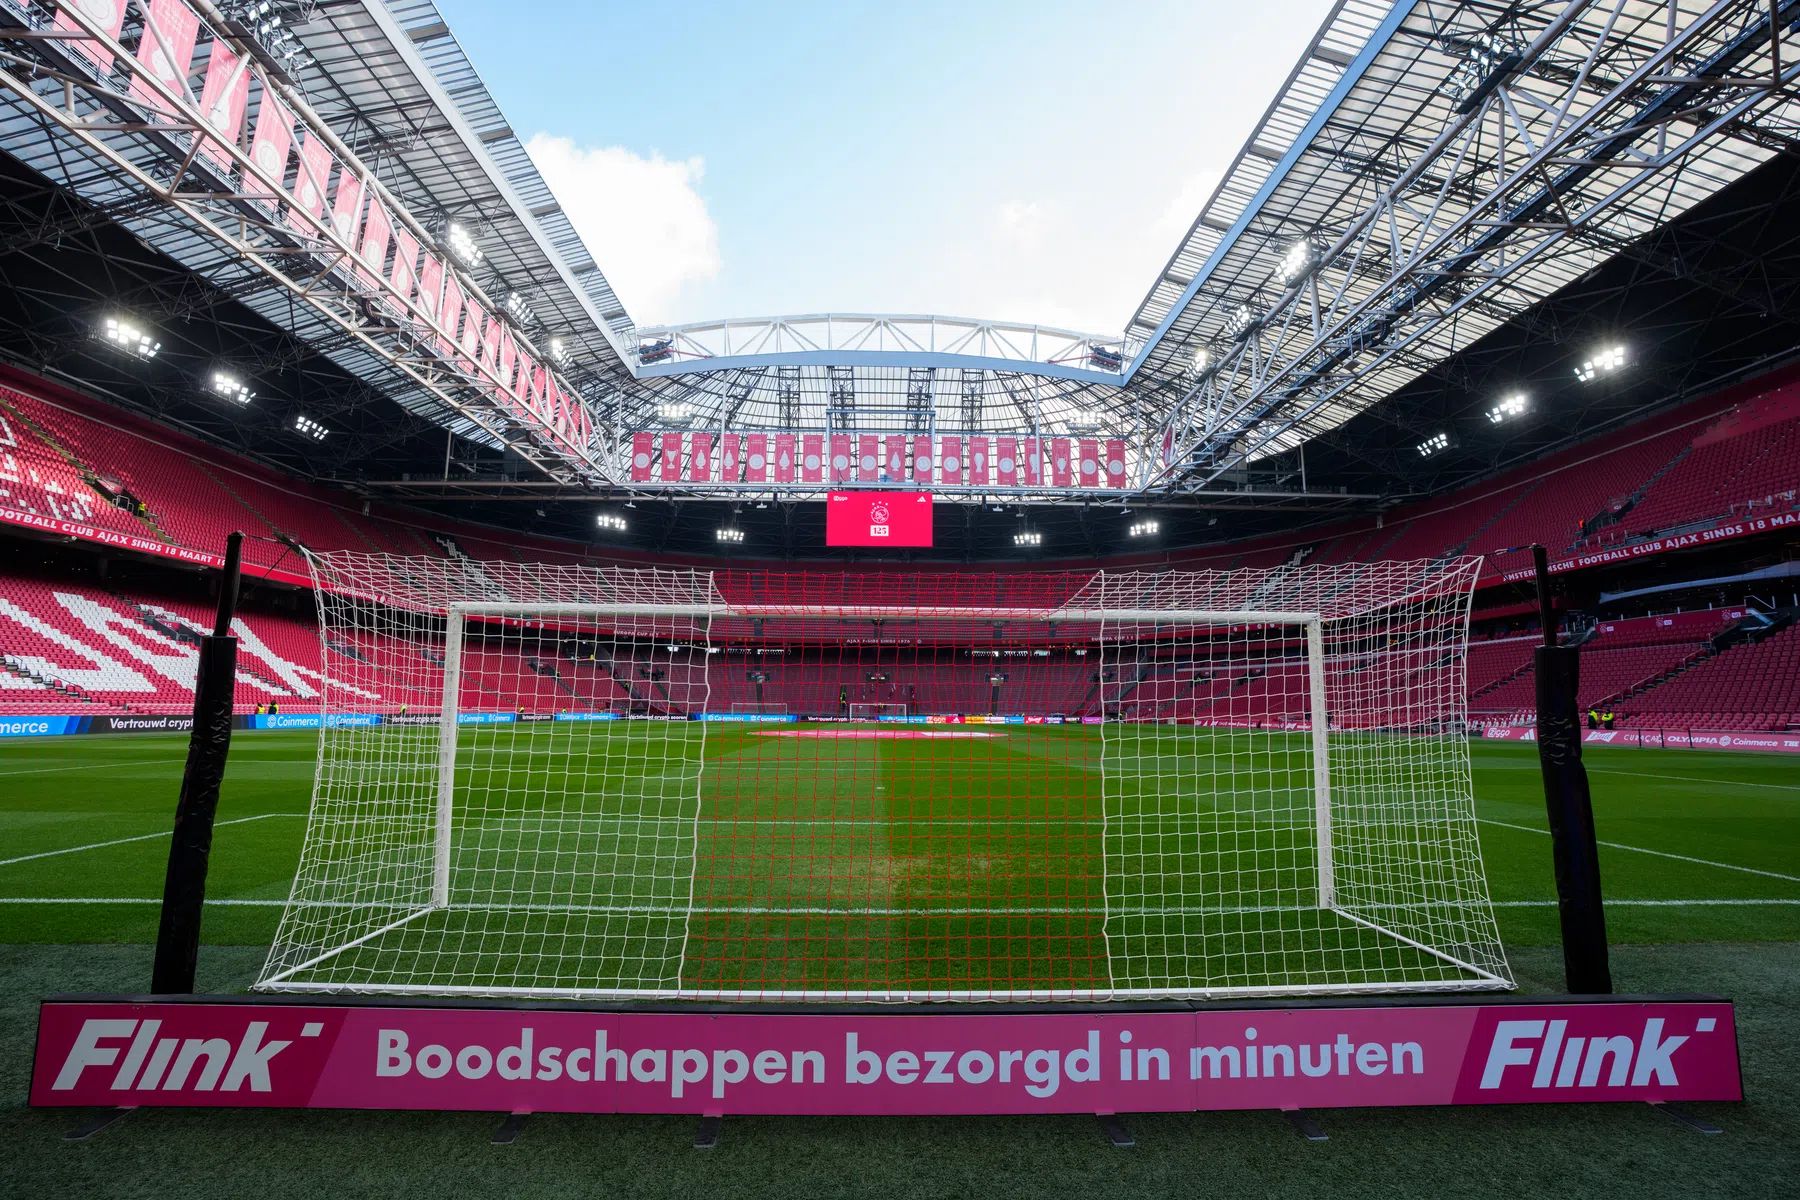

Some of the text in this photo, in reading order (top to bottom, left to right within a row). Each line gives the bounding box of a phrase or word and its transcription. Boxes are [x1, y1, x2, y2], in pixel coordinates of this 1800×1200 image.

[61, 522, 95, 538] CLUB
[97, 532, 129, 545] AJAX
[131, 539, 162, 553] SINDS
[165, 546, 177, 556] 18
[179, 550, 213, 564] MAART
[873, 527, 887, 535] 125
[1578, 551, 1630, 567] FOOTBALL
[1632, 542, 1662, 555] CLUB
[1665, 533, 1700, 549] AJAX
[1702, 525, 1743, 541] SINDS
[1749, 519, 1766, 531] 18
[110, 717, 166, 729] Vertrouwd
[278, 716, 318, 727] Coinmerce
[1667, 735, 1718, 744] OLYMPIA
[1733, 738, 1778, 747] Coinmerce
[51, 1018, 294, 1093] Flink
[376, 1027, 1424, 1099] Boodschappen bezorgd in minuten
[1479, 1017, 1691, 1090] Flink
